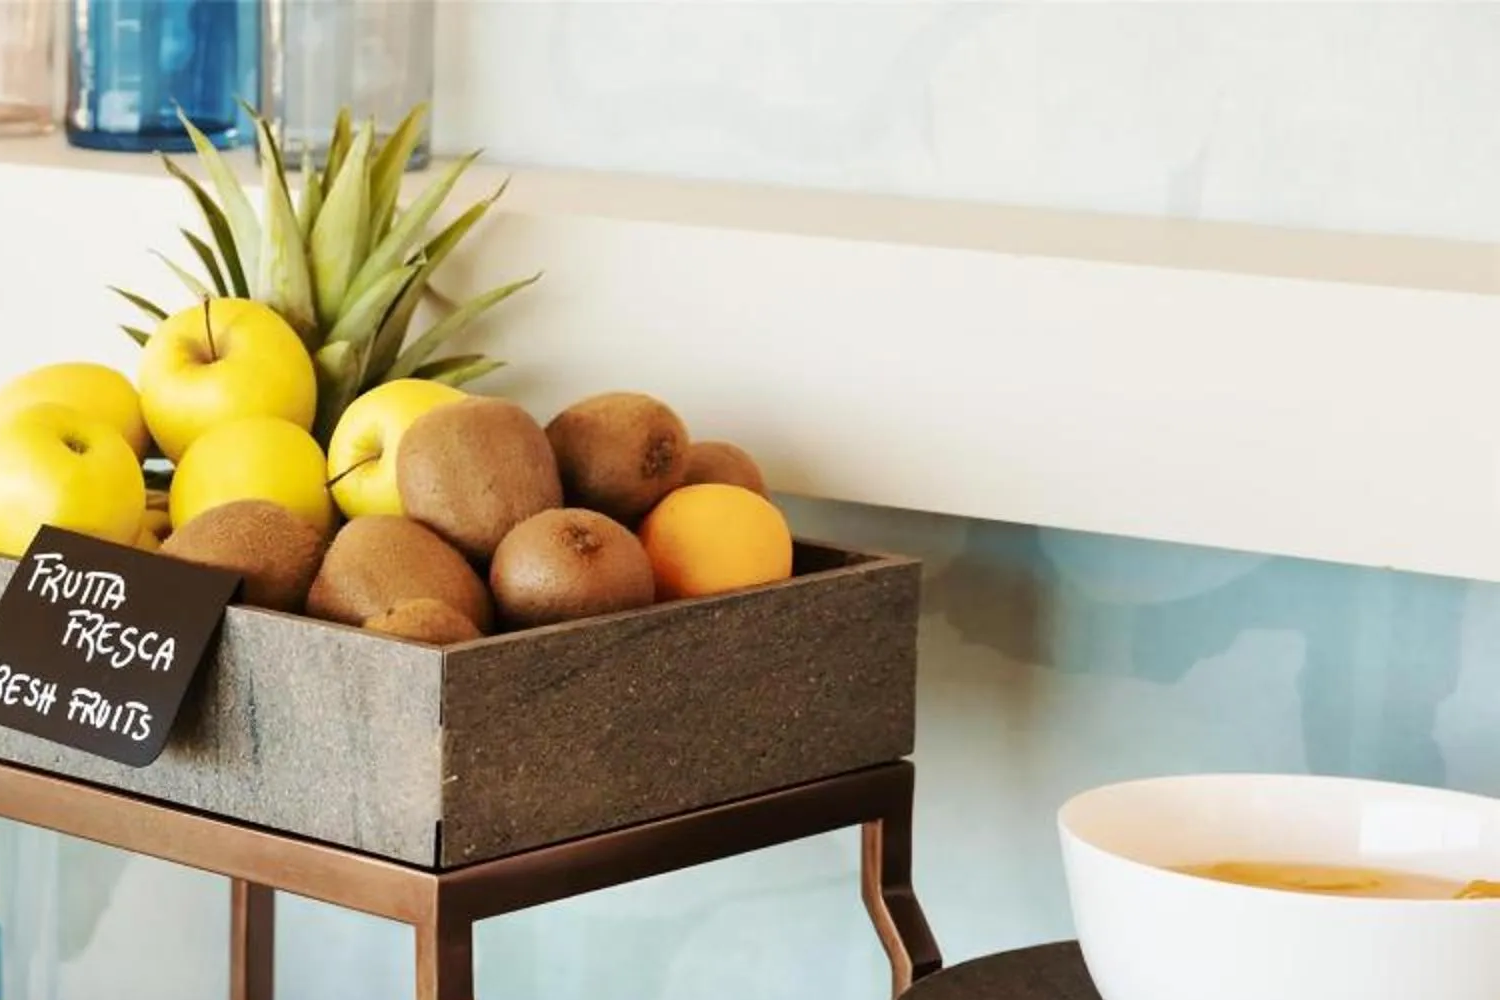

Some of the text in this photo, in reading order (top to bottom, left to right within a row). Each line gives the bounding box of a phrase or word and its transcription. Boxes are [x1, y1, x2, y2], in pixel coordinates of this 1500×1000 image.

[27, 552, 127, 611] FRUTTA
[61, 609, 177, 672] FRESCA
[67, 687, 154, 742] FRUITS
